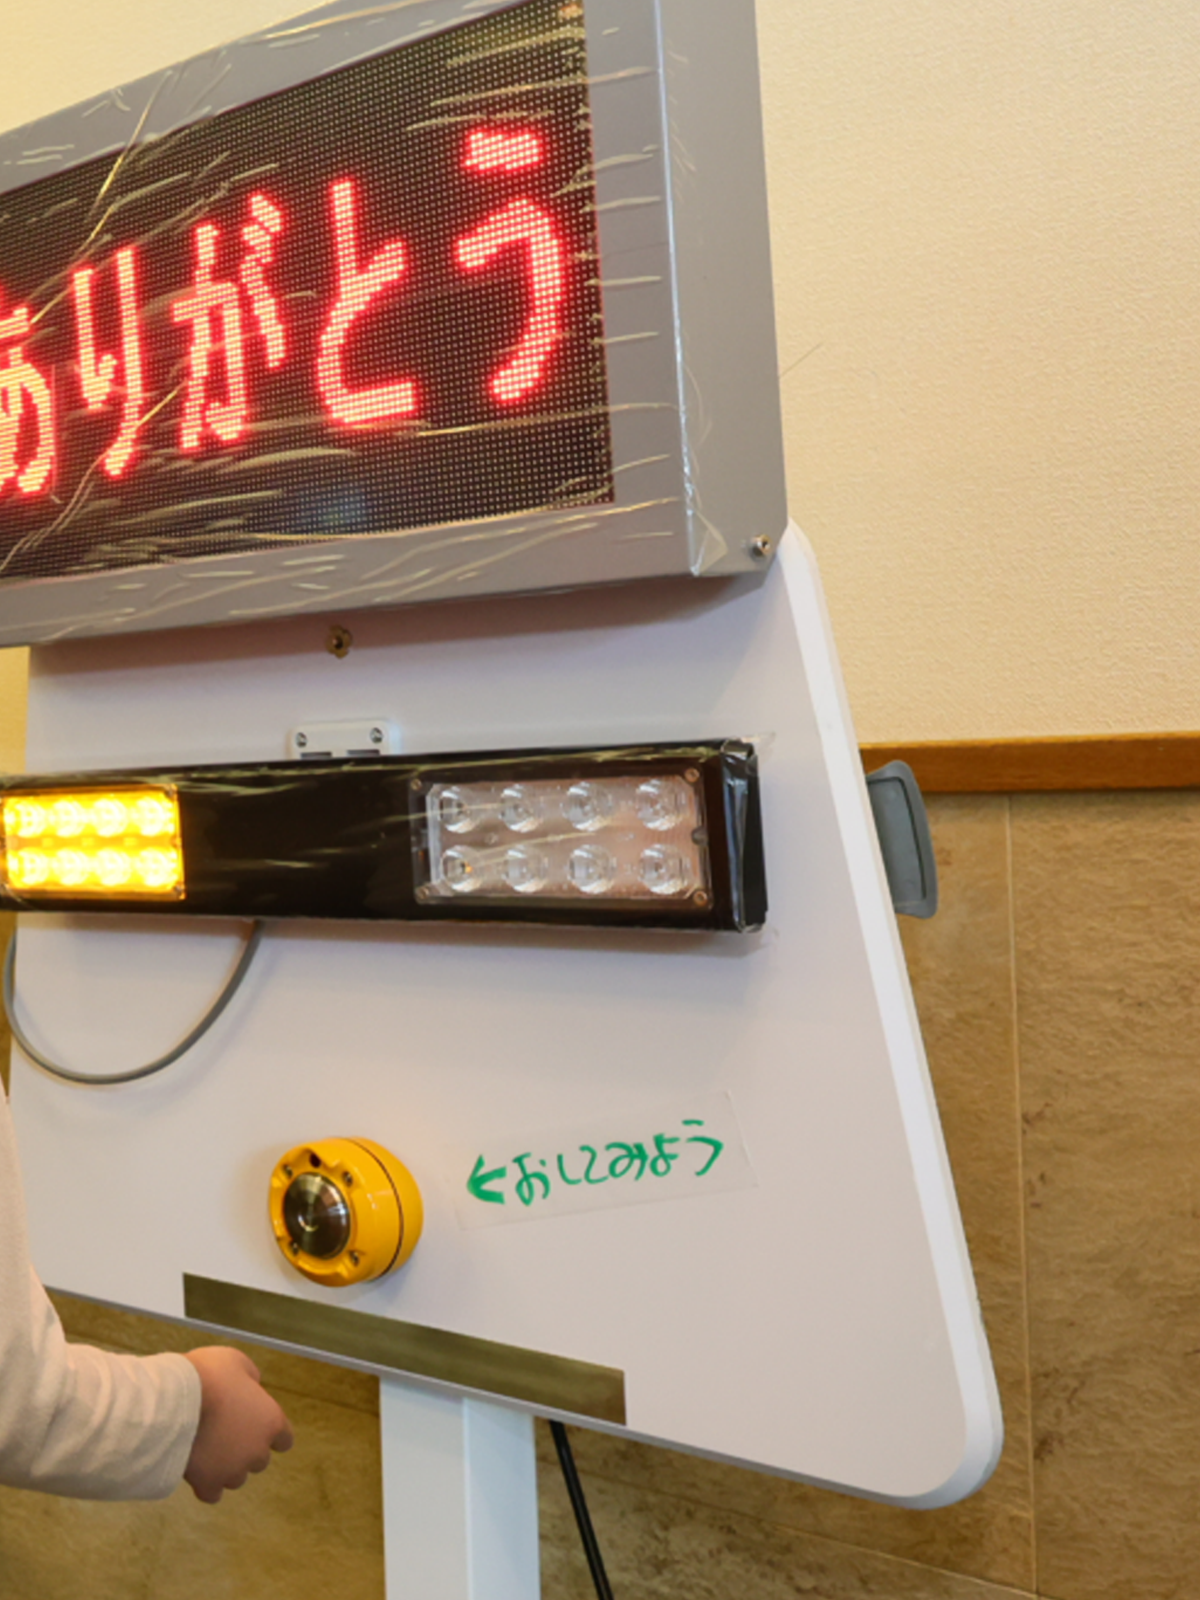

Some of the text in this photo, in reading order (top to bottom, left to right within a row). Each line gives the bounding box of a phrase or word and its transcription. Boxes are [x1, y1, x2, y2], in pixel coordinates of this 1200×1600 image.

[511, 1118, 724, 1207] おしてみよう
